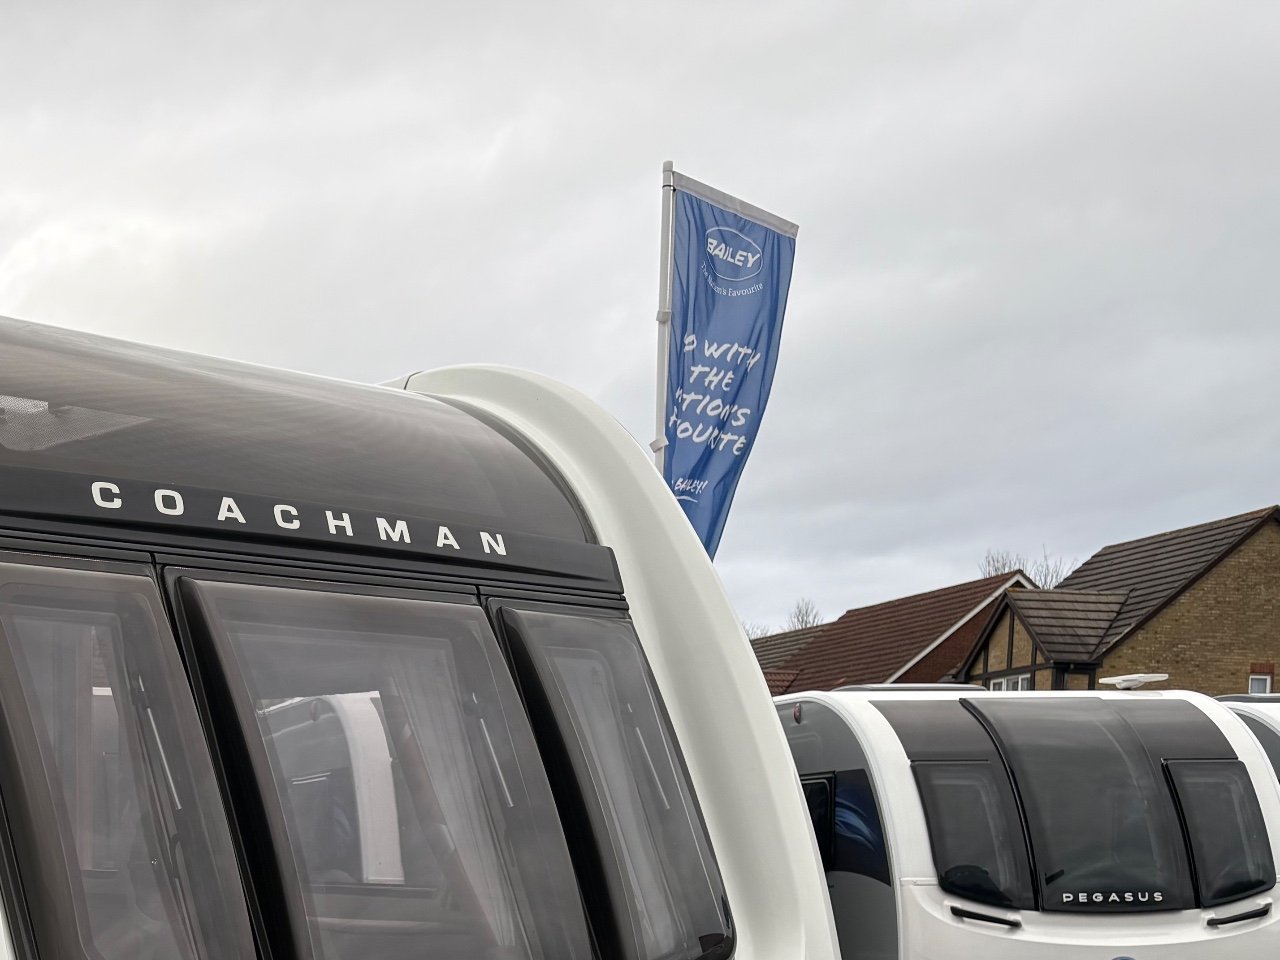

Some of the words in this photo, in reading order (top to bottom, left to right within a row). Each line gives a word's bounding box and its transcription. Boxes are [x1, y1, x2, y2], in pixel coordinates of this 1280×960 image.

[707, 238, 761, 268] BAILEY
[728, 283, 764, 297] Favourite
[704, 339, 761, 372] WITH
[690, 364, 734, 391] THE
[91, 481, 508, 556] COACHMAN
[1062, 892, 1163, 903] PEGASUS
